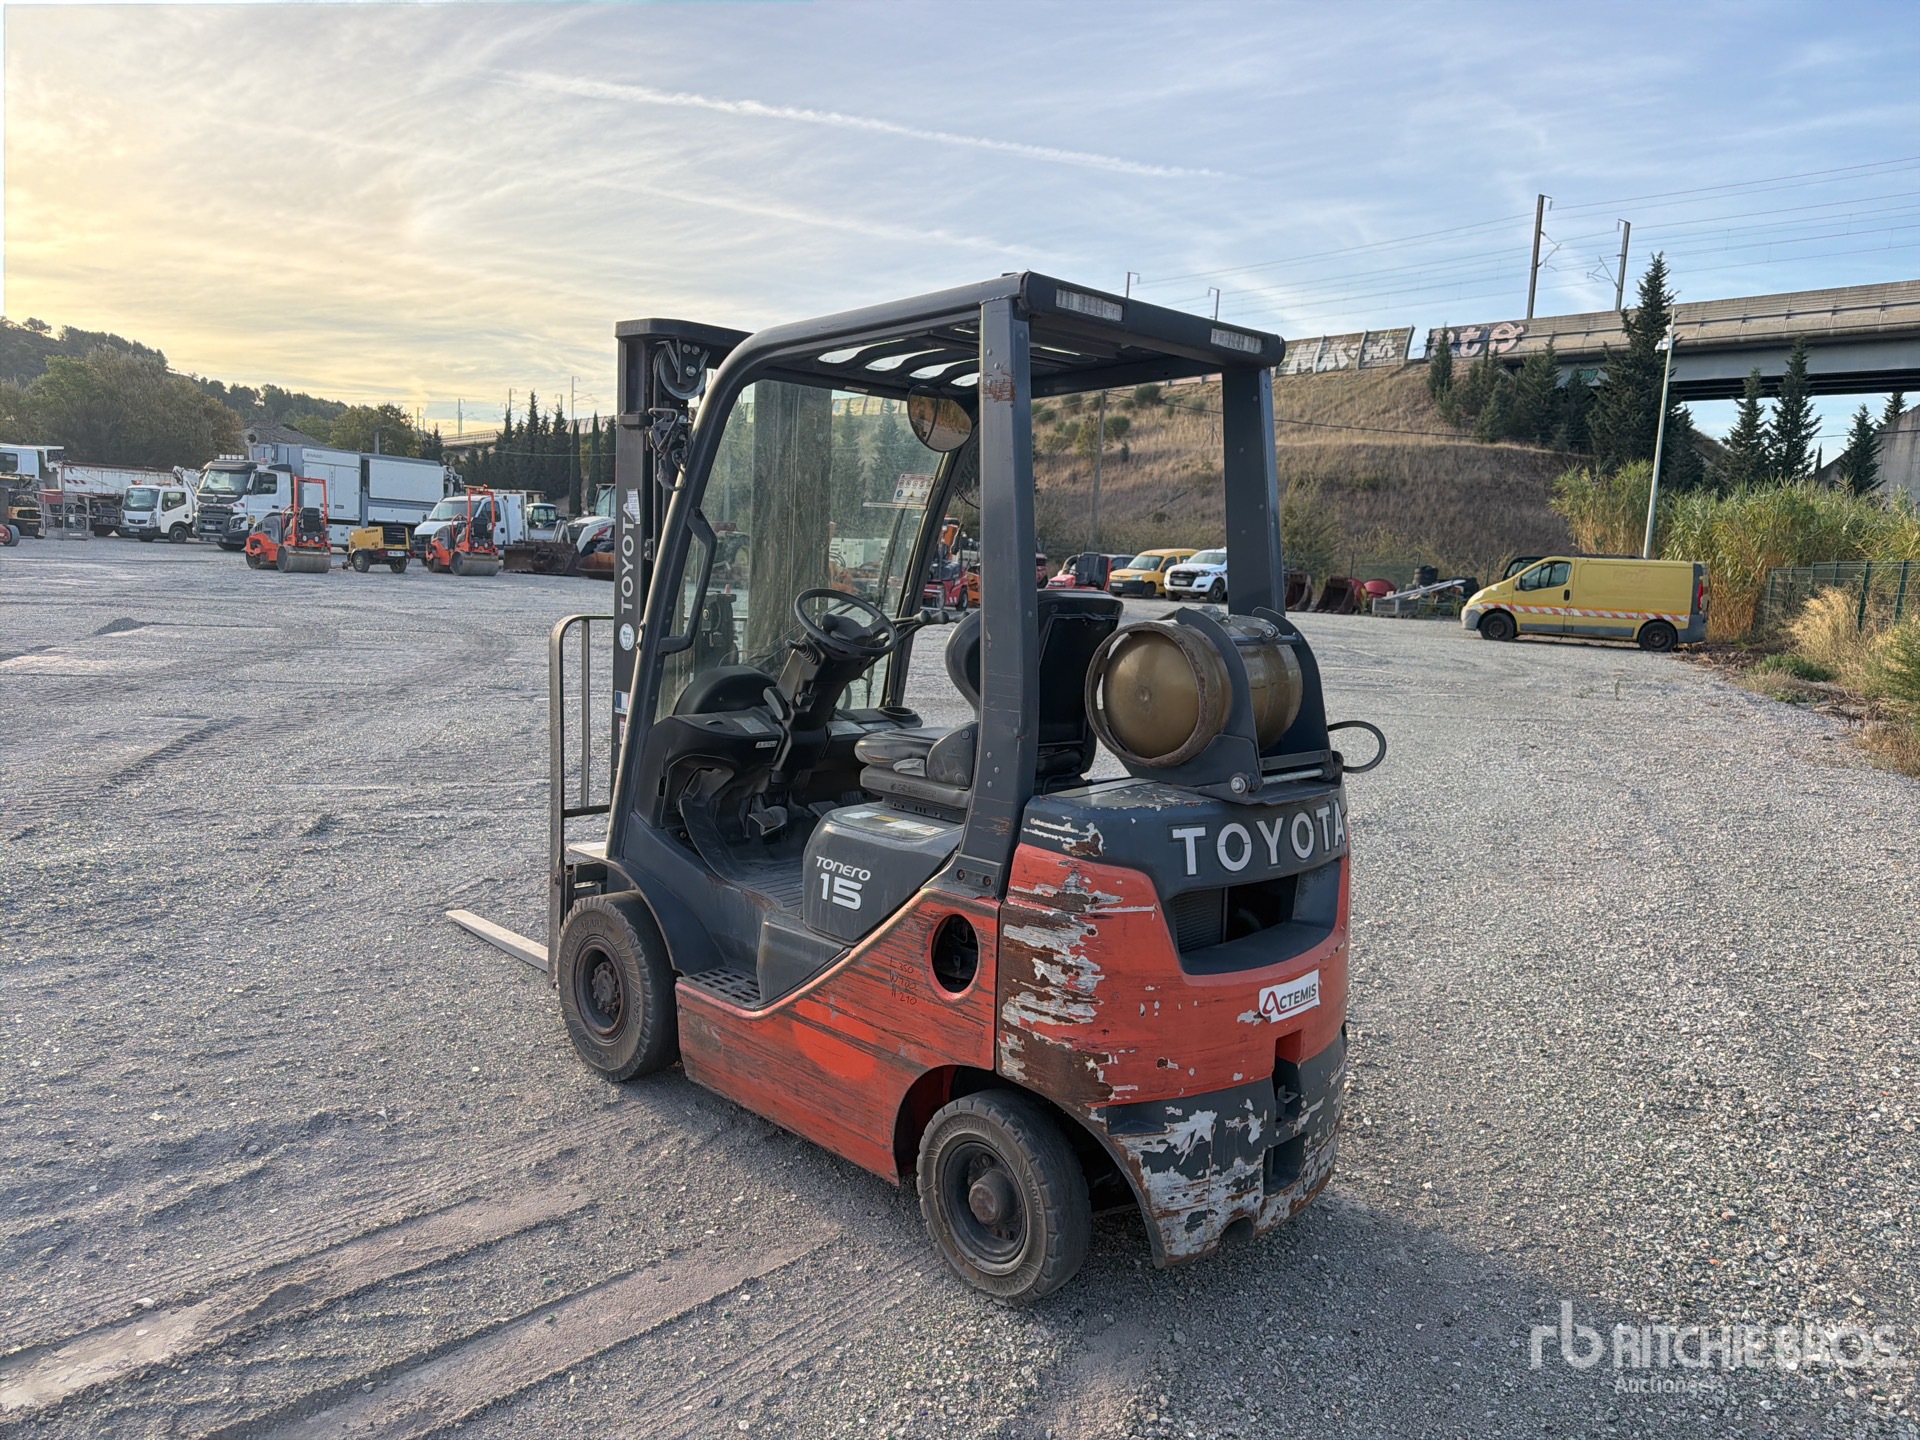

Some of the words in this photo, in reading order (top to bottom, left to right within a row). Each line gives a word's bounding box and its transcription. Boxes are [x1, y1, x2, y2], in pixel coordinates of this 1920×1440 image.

[1172, 802, 1346, 876] TOYOTA
[816, 855, 871, 882] TONERO
[820, 873, 863, 911] 15
[899, 992, 917, 1005] 210
[1262, 984, 1317, 1015] ACTEMIS
